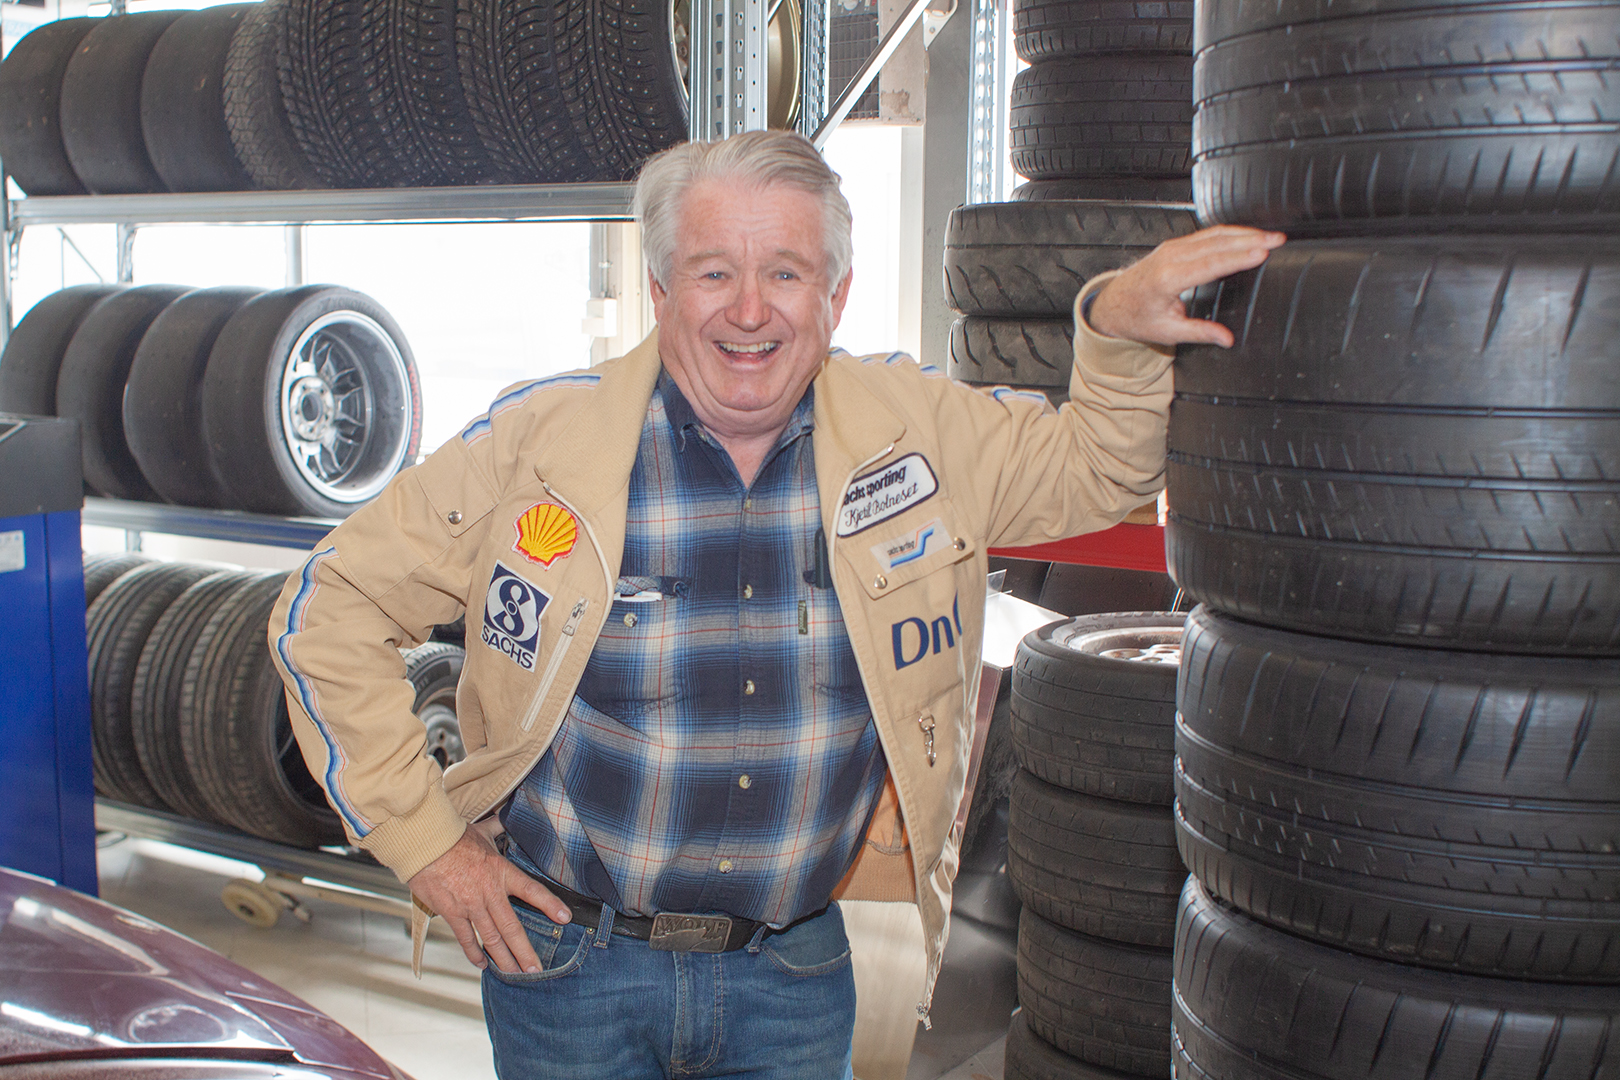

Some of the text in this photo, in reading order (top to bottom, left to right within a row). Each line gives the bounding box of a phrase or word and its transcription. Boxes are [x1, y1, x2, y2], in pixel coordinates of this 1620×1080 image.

[407, 361, 421, 456] YOKOHAMA
[842, 465, 907, 506] achs sporting
[482, 624, 534, 669] SACHS
[658, 916, 728, 935] WOLF
